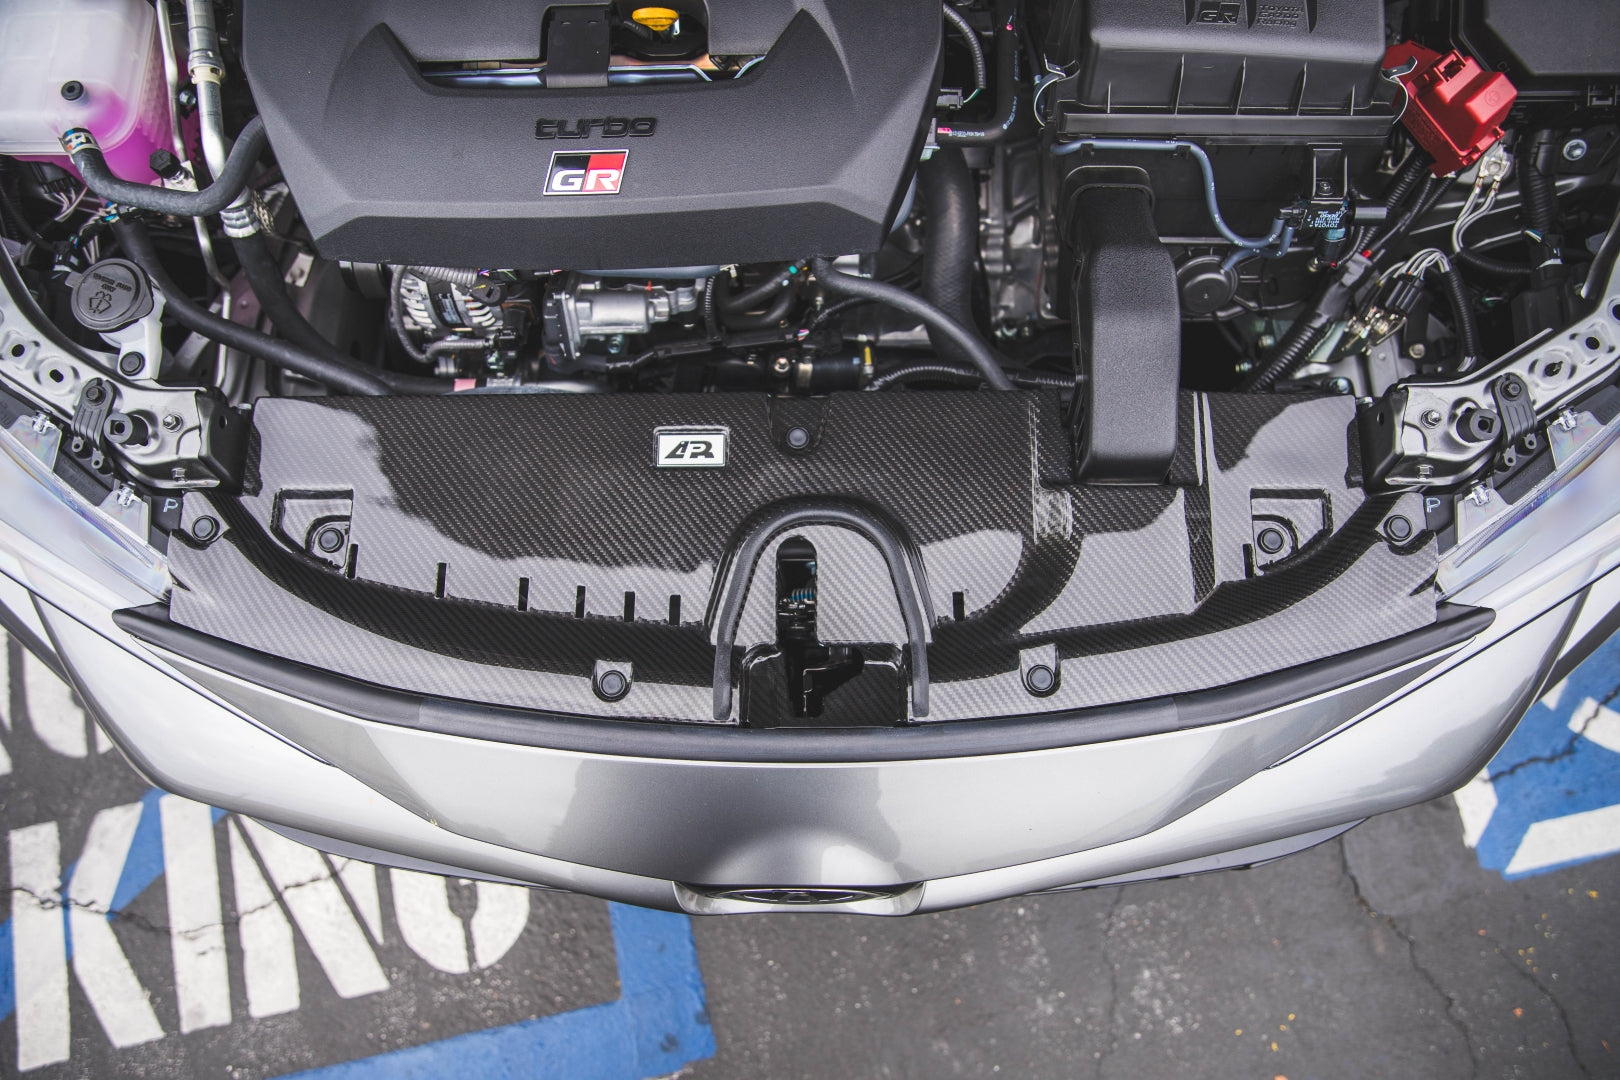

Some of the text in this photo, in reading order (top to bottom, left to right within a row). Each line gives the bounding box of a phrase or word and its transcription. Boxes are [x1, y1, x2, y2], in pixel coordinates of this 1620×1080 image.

[535, 117, 658, 140] turbo
[551, 169, 620, 191] GR
[664, 440, 715, 459] APR
[1426, 497, 1441, 513] P
